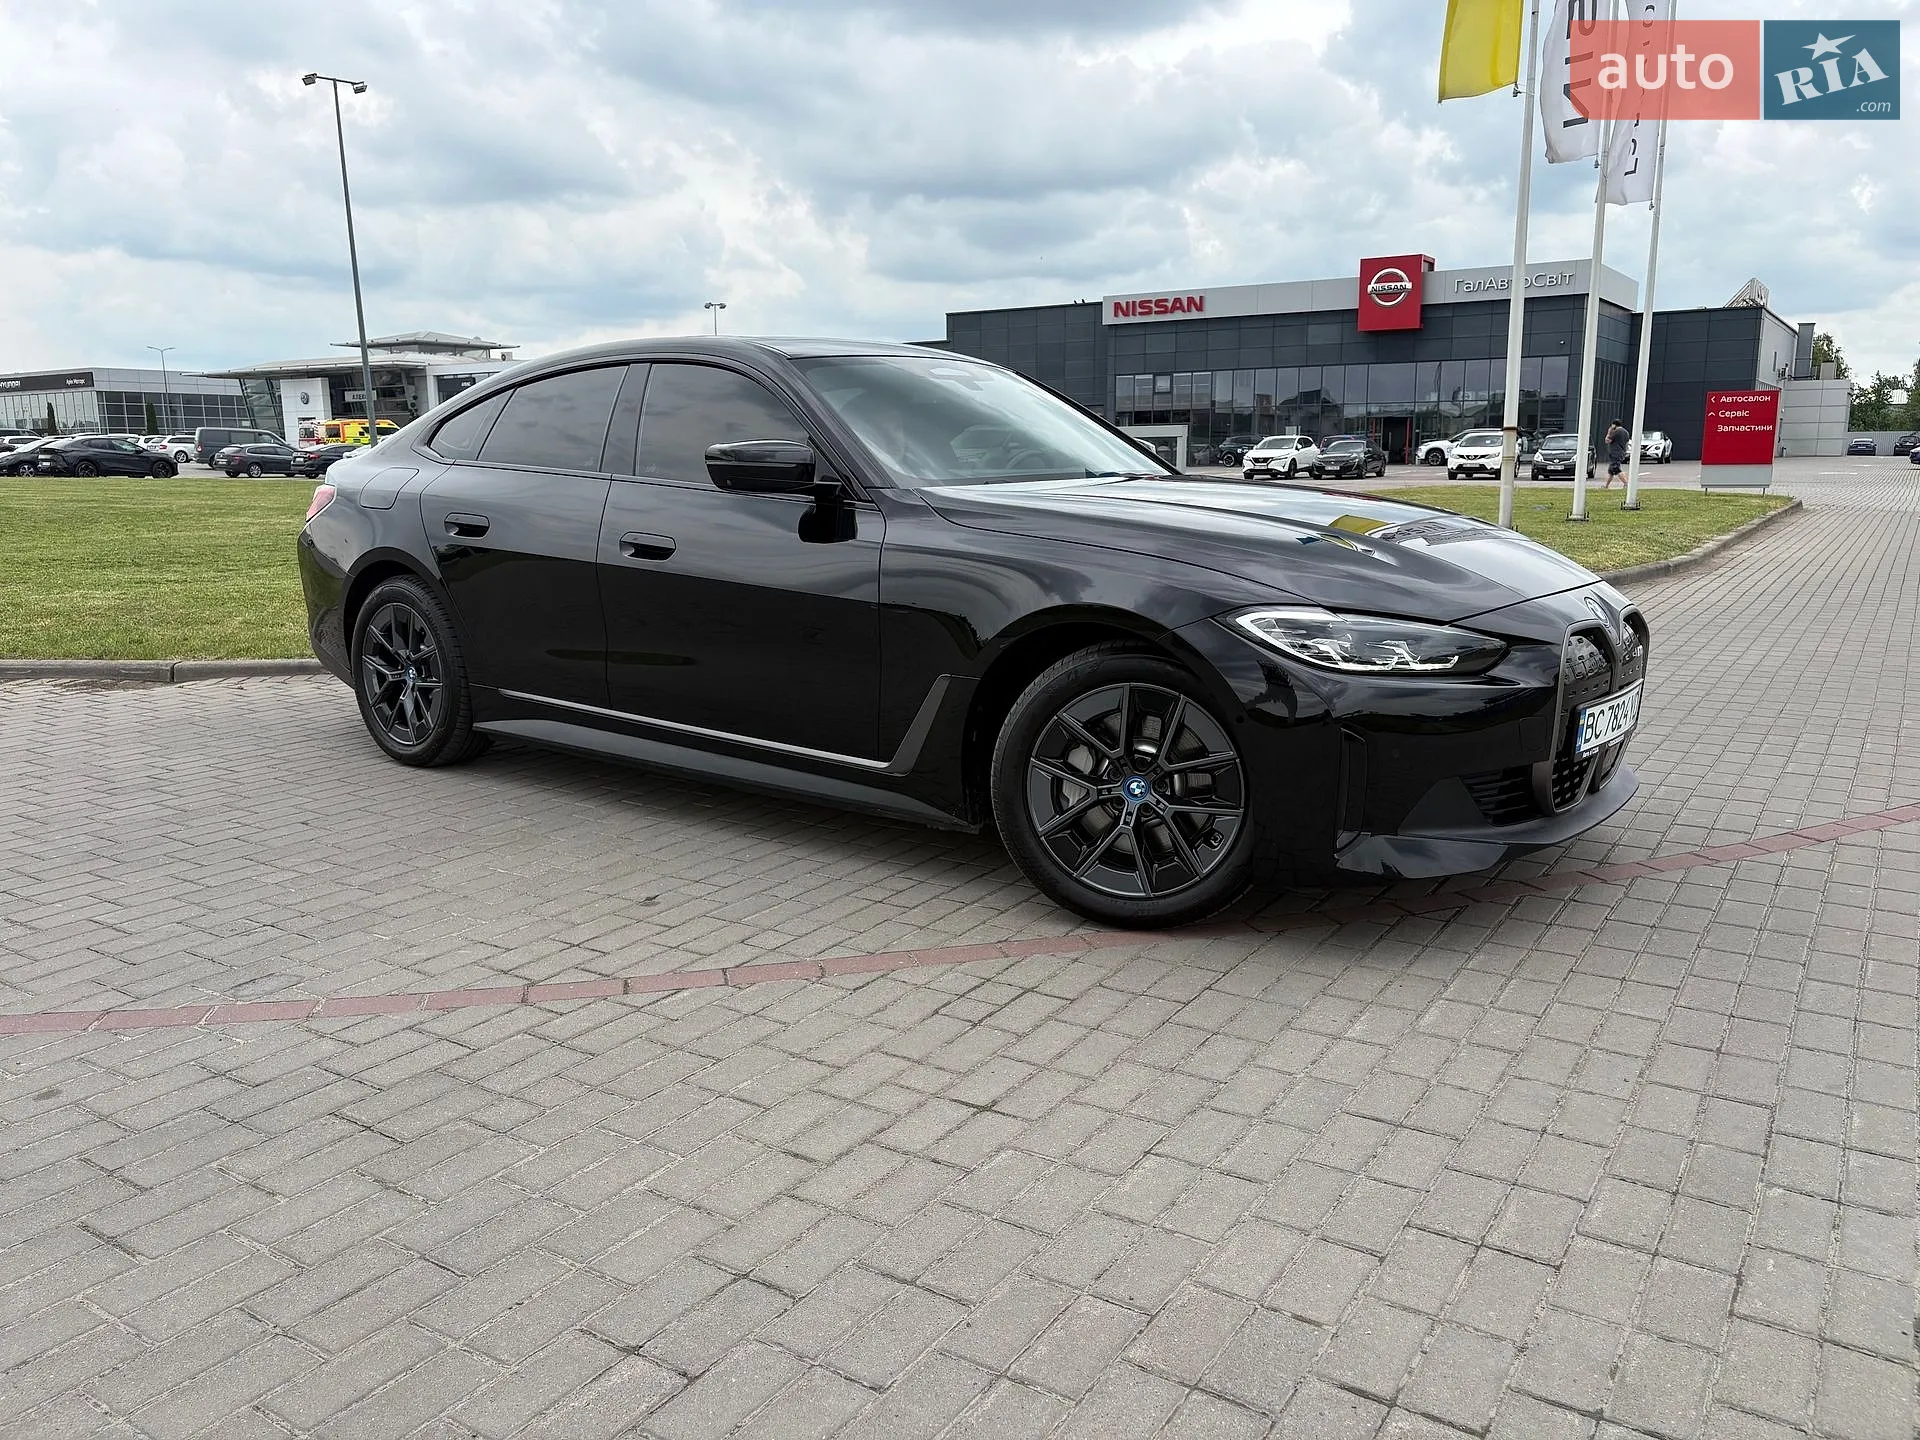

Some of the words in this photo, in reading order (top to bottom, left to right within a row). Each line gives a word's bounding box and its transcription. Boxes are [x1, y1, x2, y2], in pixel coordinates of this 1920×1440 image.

[1371, 284, 1407, 293] NISSAN
[1454, 271, 1576, 293] ГалАвоСвіт
[1113, 296, 1204, 318] NISSAN
[1718, 410, 1750, 418] Сервіс
[1717, 424, 1772, 432] Запчастини
[1583, 709, 1605, 744] BC
